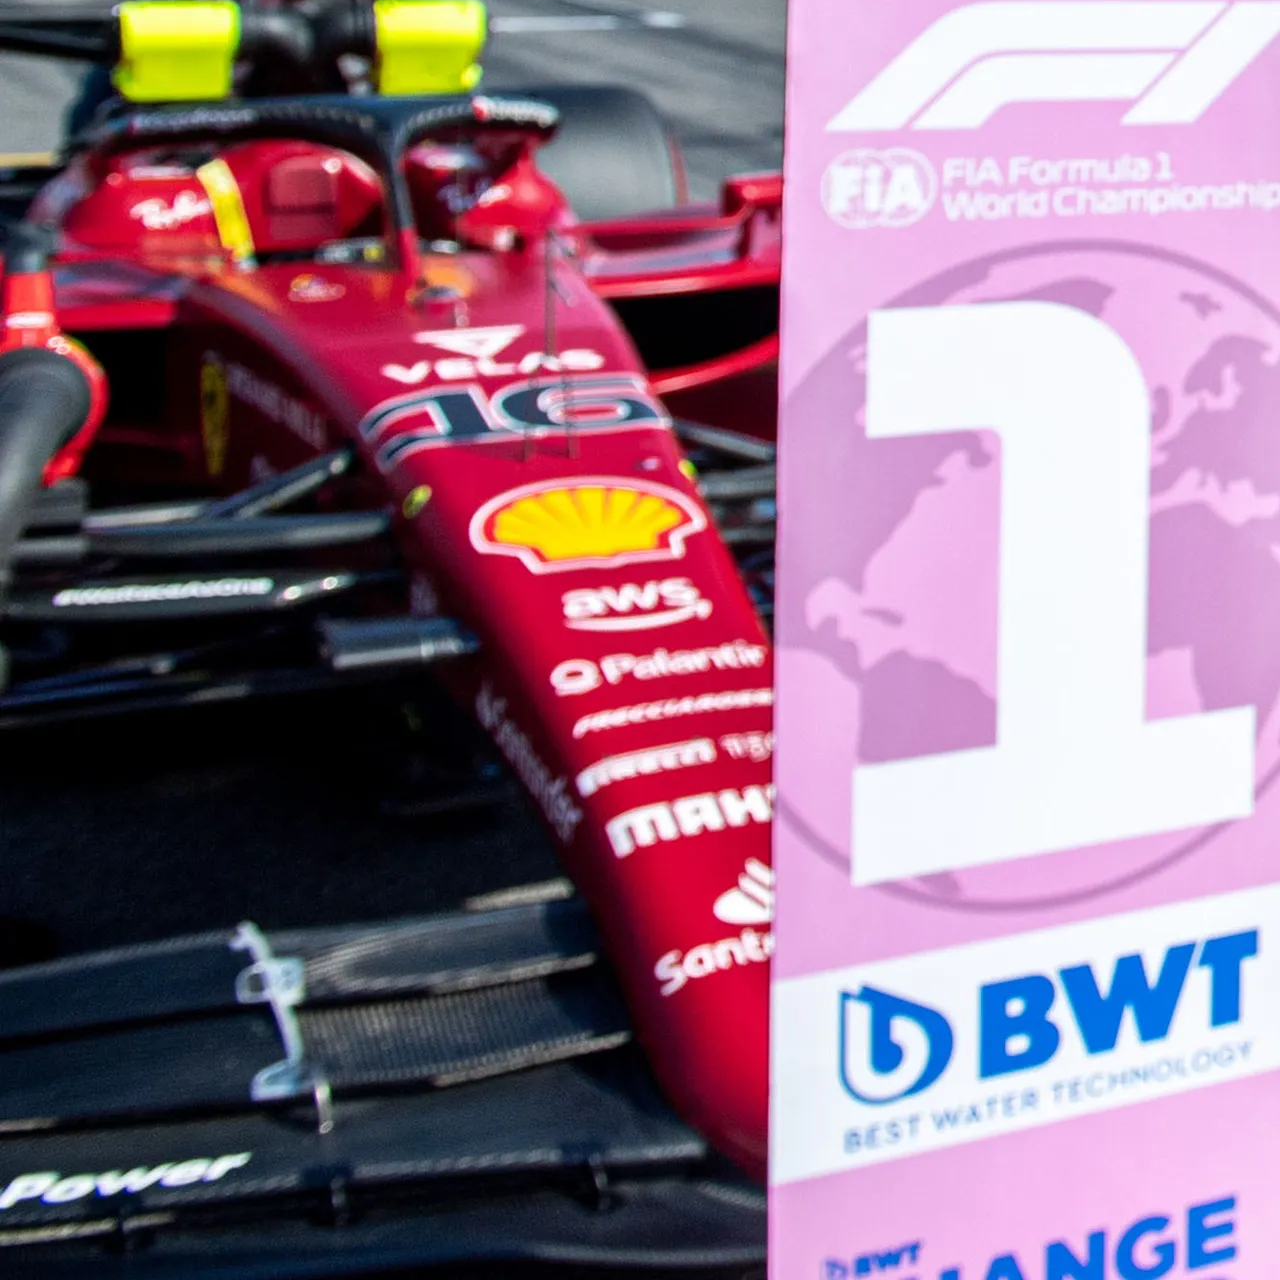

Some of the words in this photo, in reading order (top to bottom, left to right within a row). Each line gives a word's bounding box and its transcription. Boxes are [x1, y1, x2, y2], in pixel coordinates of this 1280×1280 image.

[828, 166, 926, 213] FIA
[942, 157, 1005, 188] FIA
[1008, 154, 1152, 186] Formula
[1156, 153, 1174, 180] 1
[942, 187, 1056, 221] World
[382, 349, 605, 384] VELAS
[359, 373, 673, 473] 16
[561, 577, 702, 619] aws
[851, 300, 1257, 888] 1
[978, 928, 1259, 1080] BWT
[843, 1113, 921, 1155] BEST
[931, 1087, 1041, 1132] WATER
[1052, 1040, 1256, 1107] TECHNOLOGY
[853, 1240, 921, 1277] BWT
